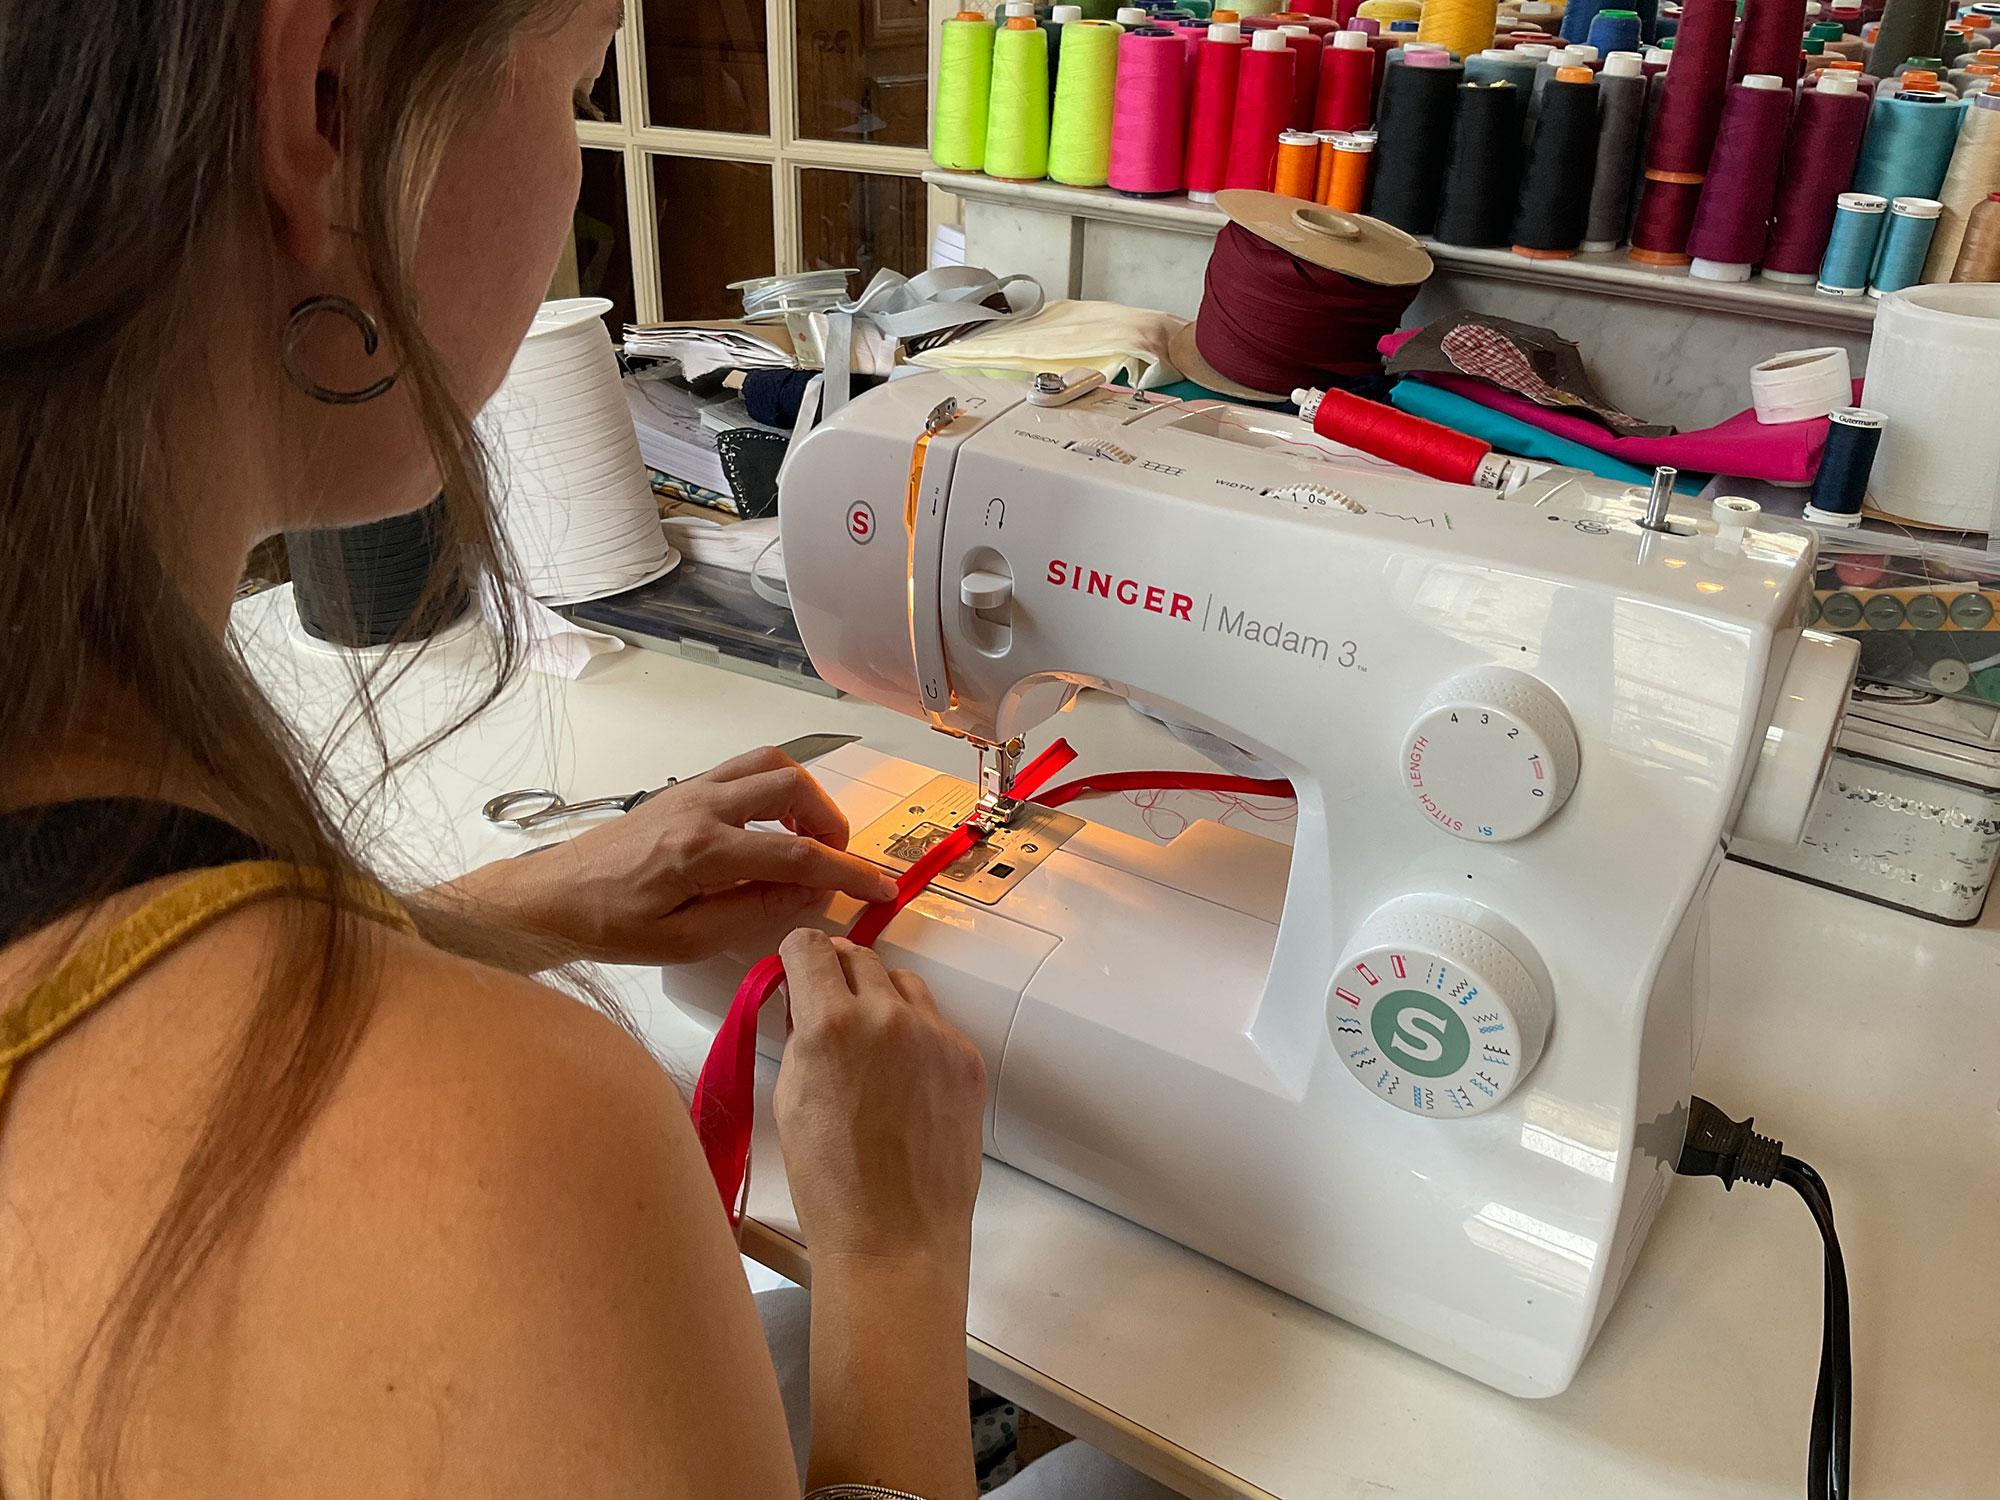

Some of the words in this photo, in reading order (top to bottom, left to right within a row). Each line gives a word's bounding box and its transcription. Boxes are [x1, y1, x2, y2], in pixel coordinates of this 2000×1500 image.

[1013, 429, 1060, 445] TENSION
[1095, 448, 1102, 458] 5
[1215, 479, 1256, 492] WIDTH
[852, 511, 869, 535] S
[1046, 559, 1194, 622] SINGER
[1217, 606, 1329, 661] Madam
[1450, 712, 1459, 724] 4
[1480, 713, 1489, 725] 3
[1507, 728, 1519, 739] 2
[1409, 736, 1429, 788] LENGTH
[1418, 793, 1463, 832] STITCH
[1390, 1006, 1448, 1062] S
